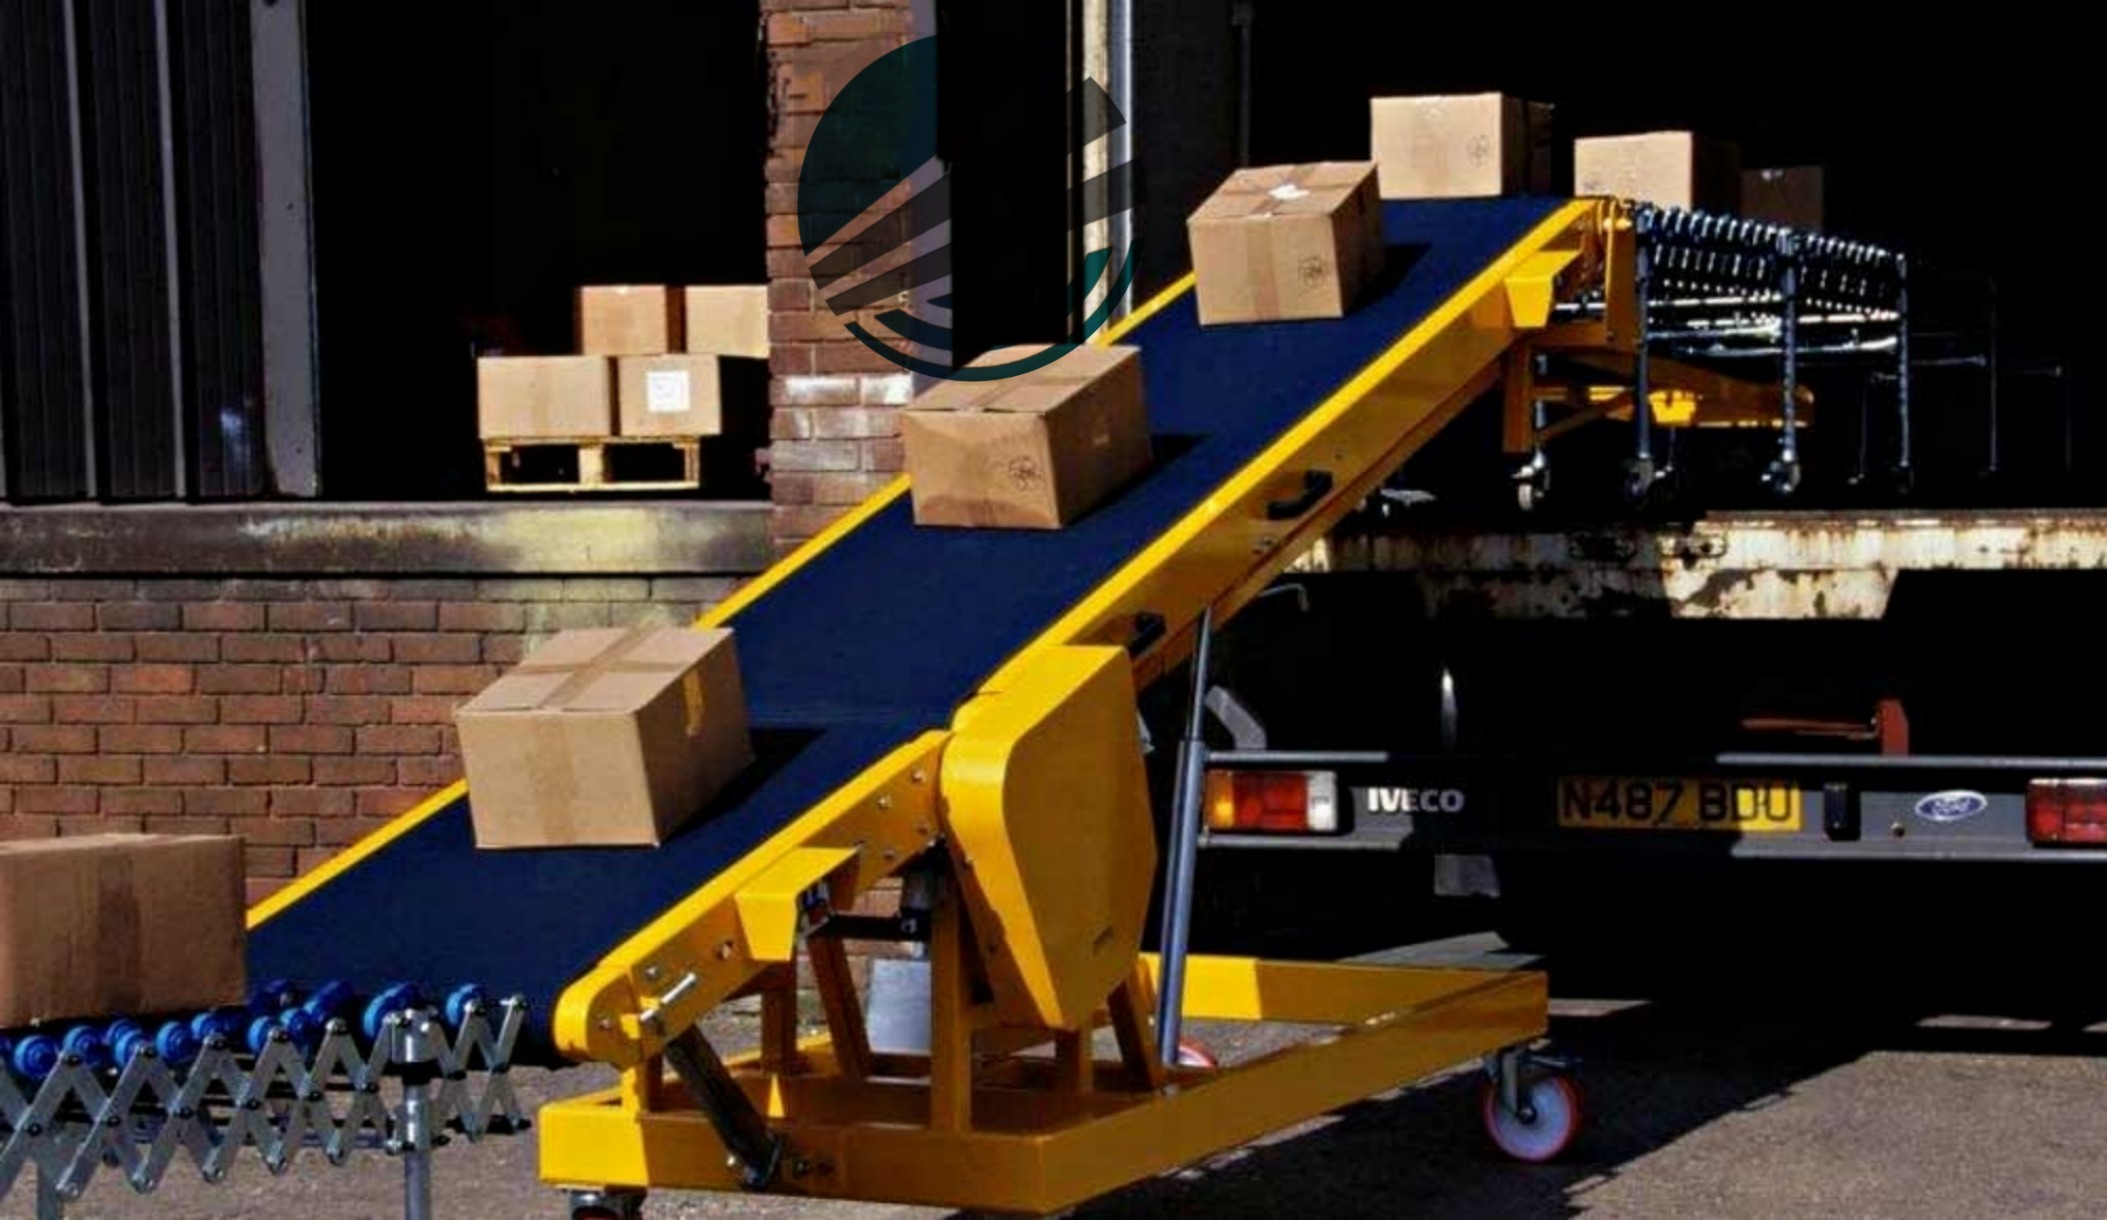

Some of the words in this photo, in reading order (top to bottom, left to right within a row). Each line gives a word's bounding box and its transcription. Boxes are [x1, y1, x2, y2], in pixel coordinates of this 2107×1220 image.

[1368, 787, 1464, 812] IVECO
[1563, 781, 1684, 824] N487
[1700, 781, 1791, 822] BDU
